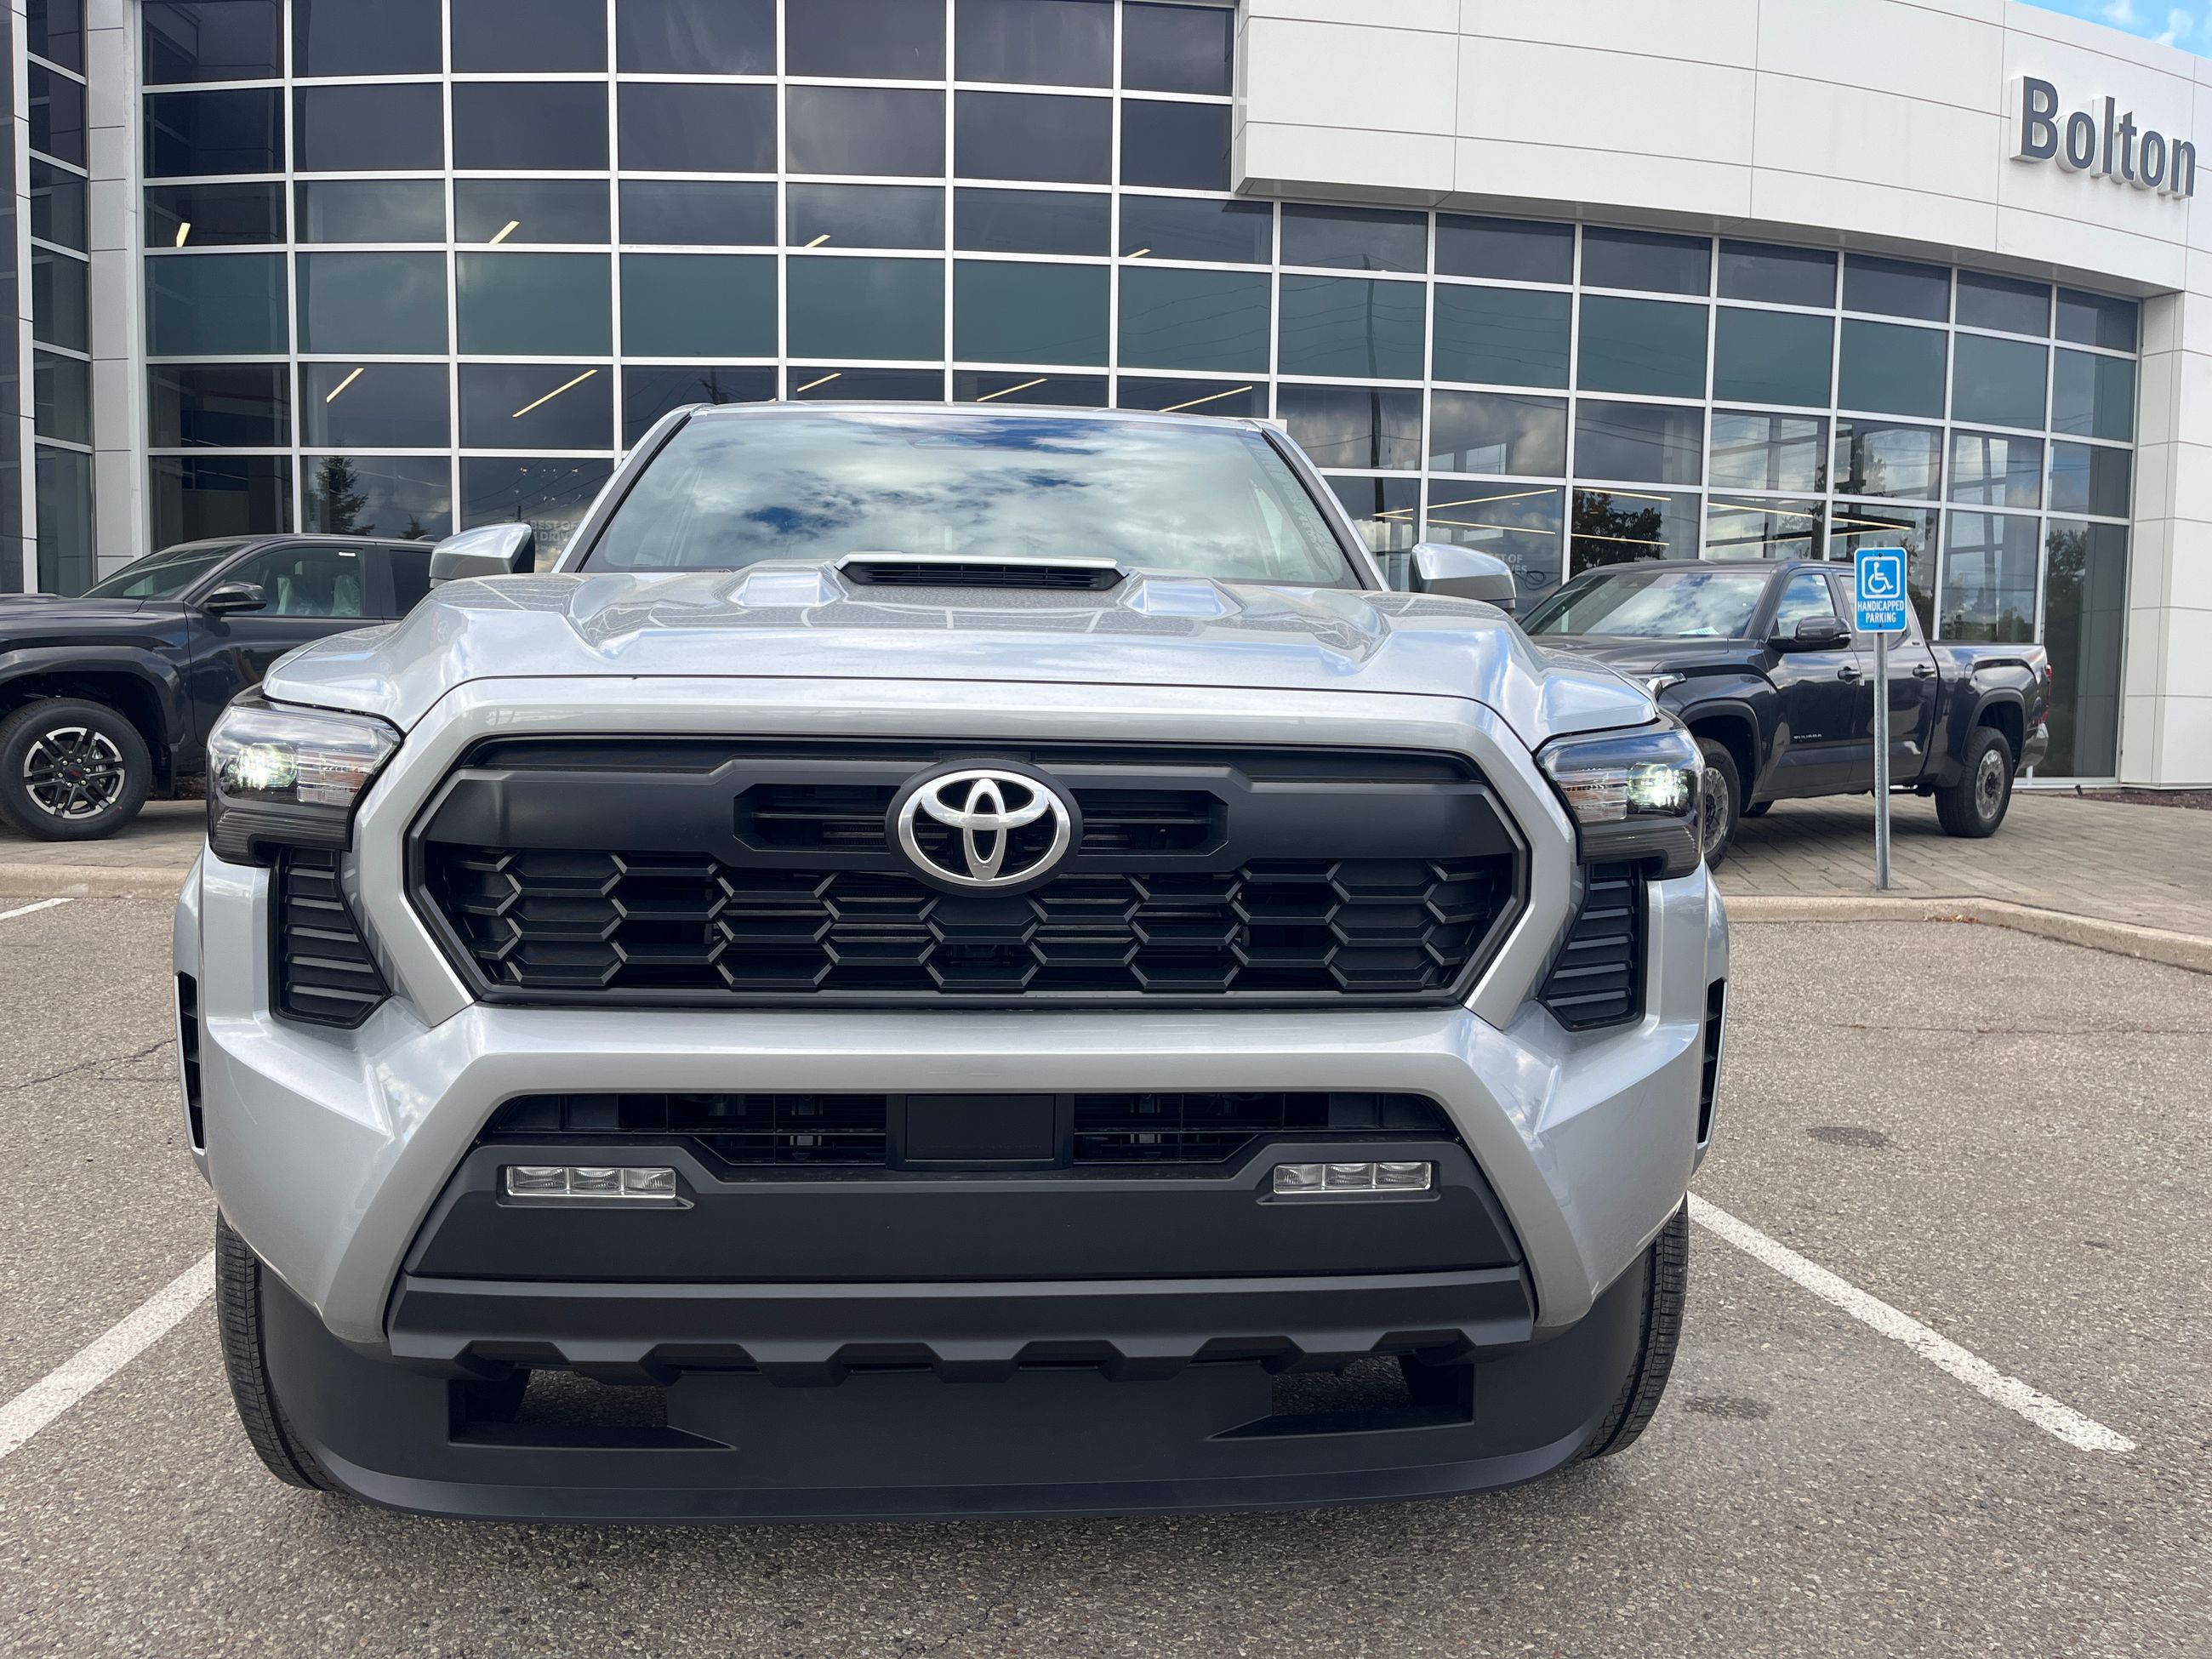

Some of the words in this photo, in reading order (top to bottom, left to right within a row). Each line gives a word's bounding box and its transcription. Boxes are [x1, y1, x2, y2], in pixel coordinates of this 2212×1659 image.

[2020, 75, 2197, 197] Bolton
[1508, 553, 1523, 563] OF
[1857, 600, 1905, 612] HANDICAPPED
[1865, 612, 1896, 623] PARKING
